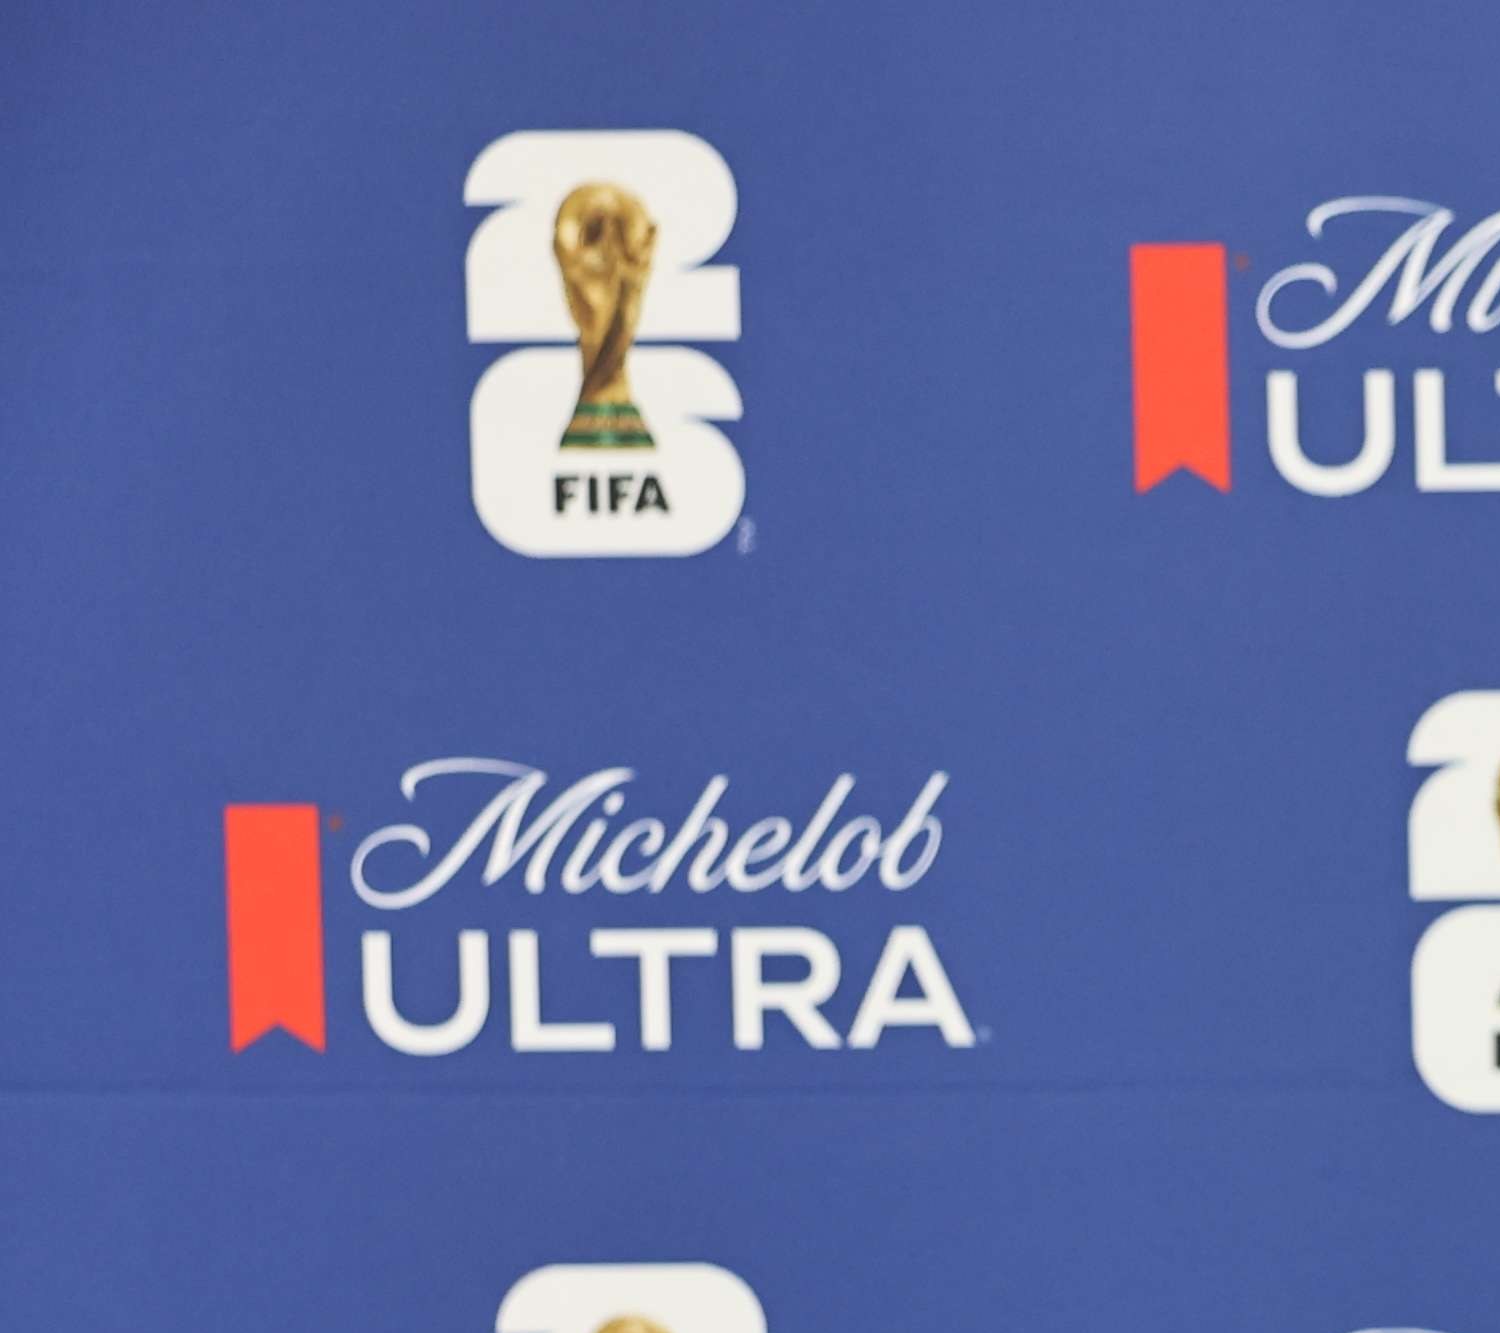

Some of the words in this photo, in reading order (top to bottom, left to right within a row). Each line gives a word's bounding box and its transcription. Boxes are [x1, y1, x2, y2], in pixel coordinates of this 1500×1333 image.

[552, 473, 671, 515] FIFA
[348, 755, 950, 912] Michelob
[359, 923, 978, 1058] ULTRA
